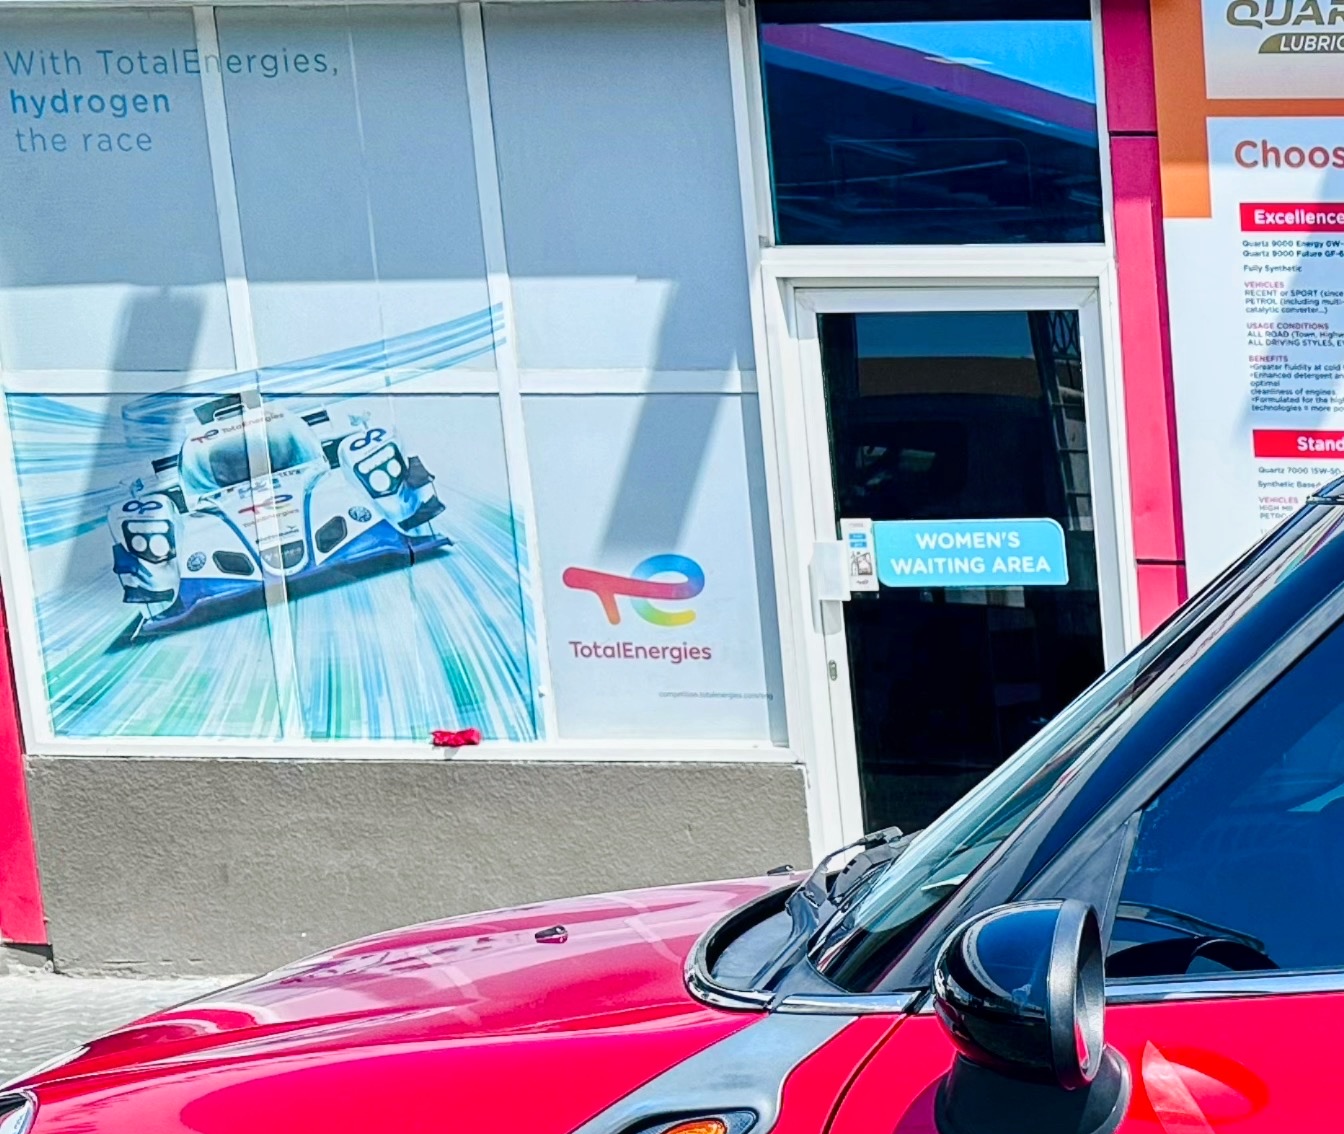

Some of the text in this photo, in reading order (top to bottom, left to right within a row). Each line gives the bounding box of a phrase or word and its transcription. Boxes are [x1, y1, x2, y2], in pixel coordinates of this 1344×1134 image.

[4, 48, 339, 79] With TotalEnergies,
[9, 88, 172, 119] hydrogen
[15, 127, 153, 153] the race
[1296, 239, 1325, 250] Energy
[915, 532, 1021, 551] WOMEN'S
[890, 555, 1052, 576] WAITING AREA
[568, 640, 713, 664] TotalEnergies
